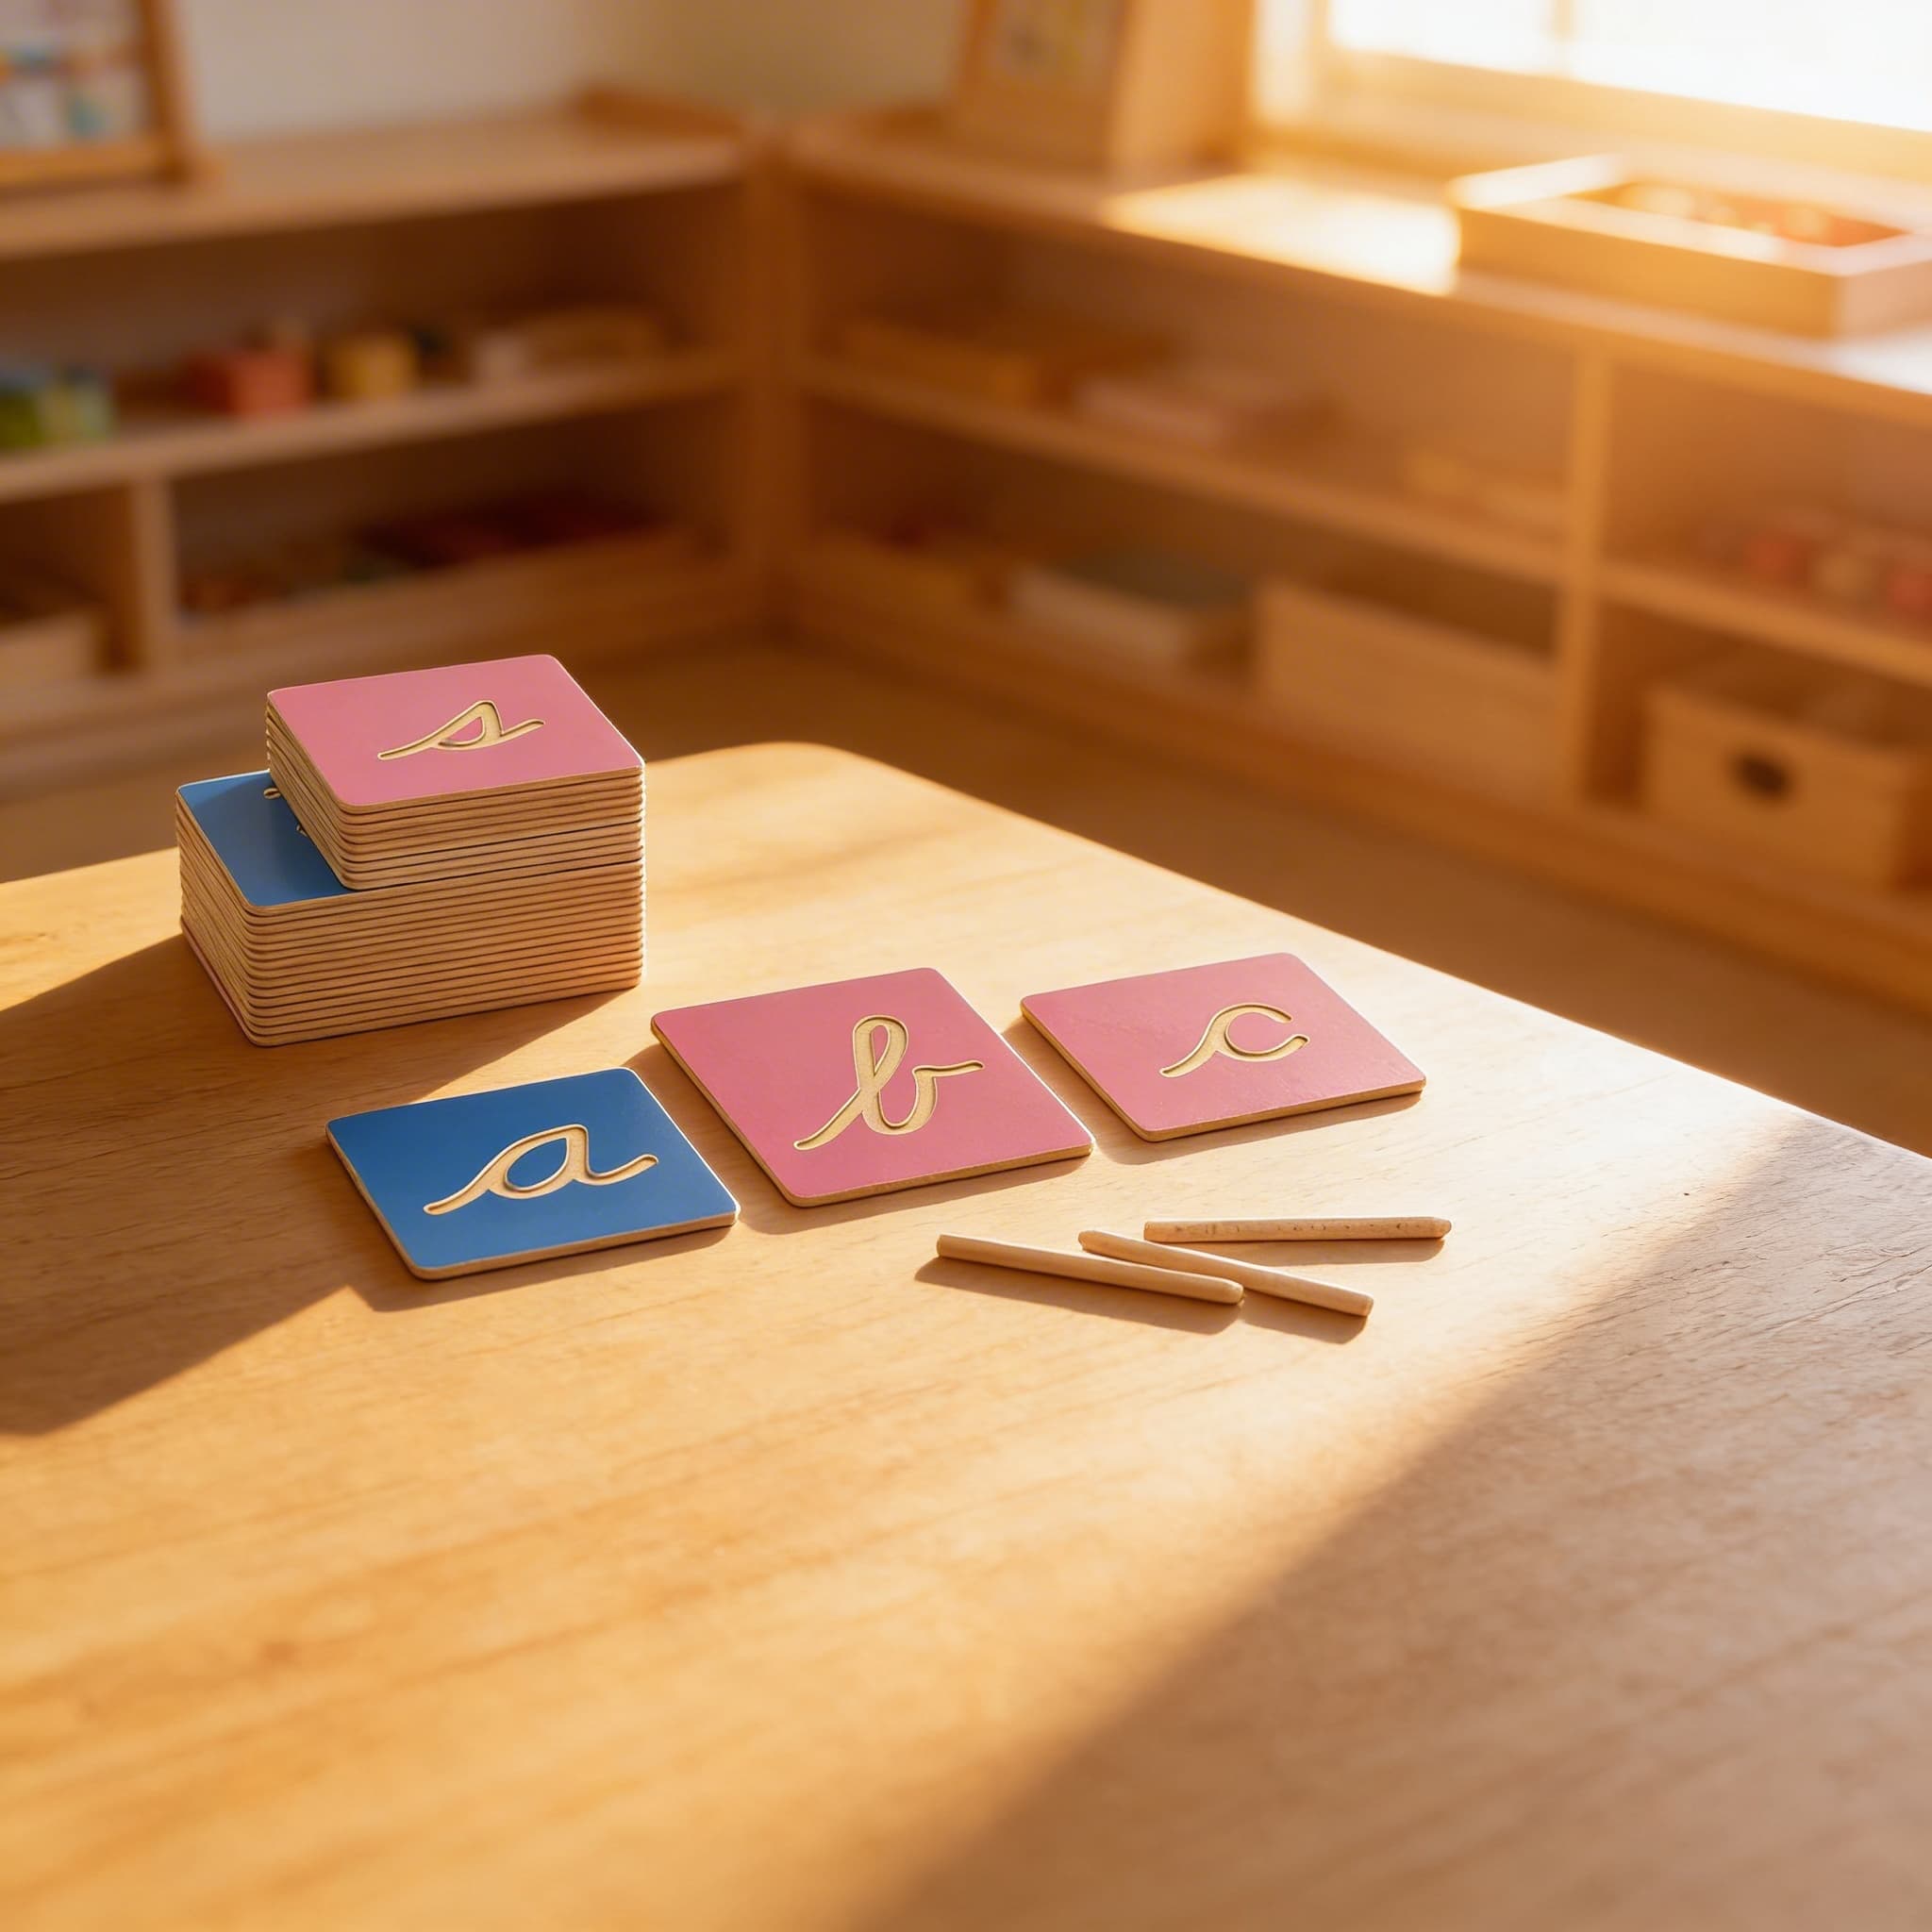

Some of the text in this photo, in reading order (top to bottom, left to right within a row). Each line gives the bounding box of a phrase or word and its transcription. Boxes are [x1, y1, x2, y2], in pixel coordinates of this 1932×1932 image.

[793, 1014, 984, 1151] b
[1160, 1002, 1311, 1078] c
[423, 1124, 658, 1215] a
